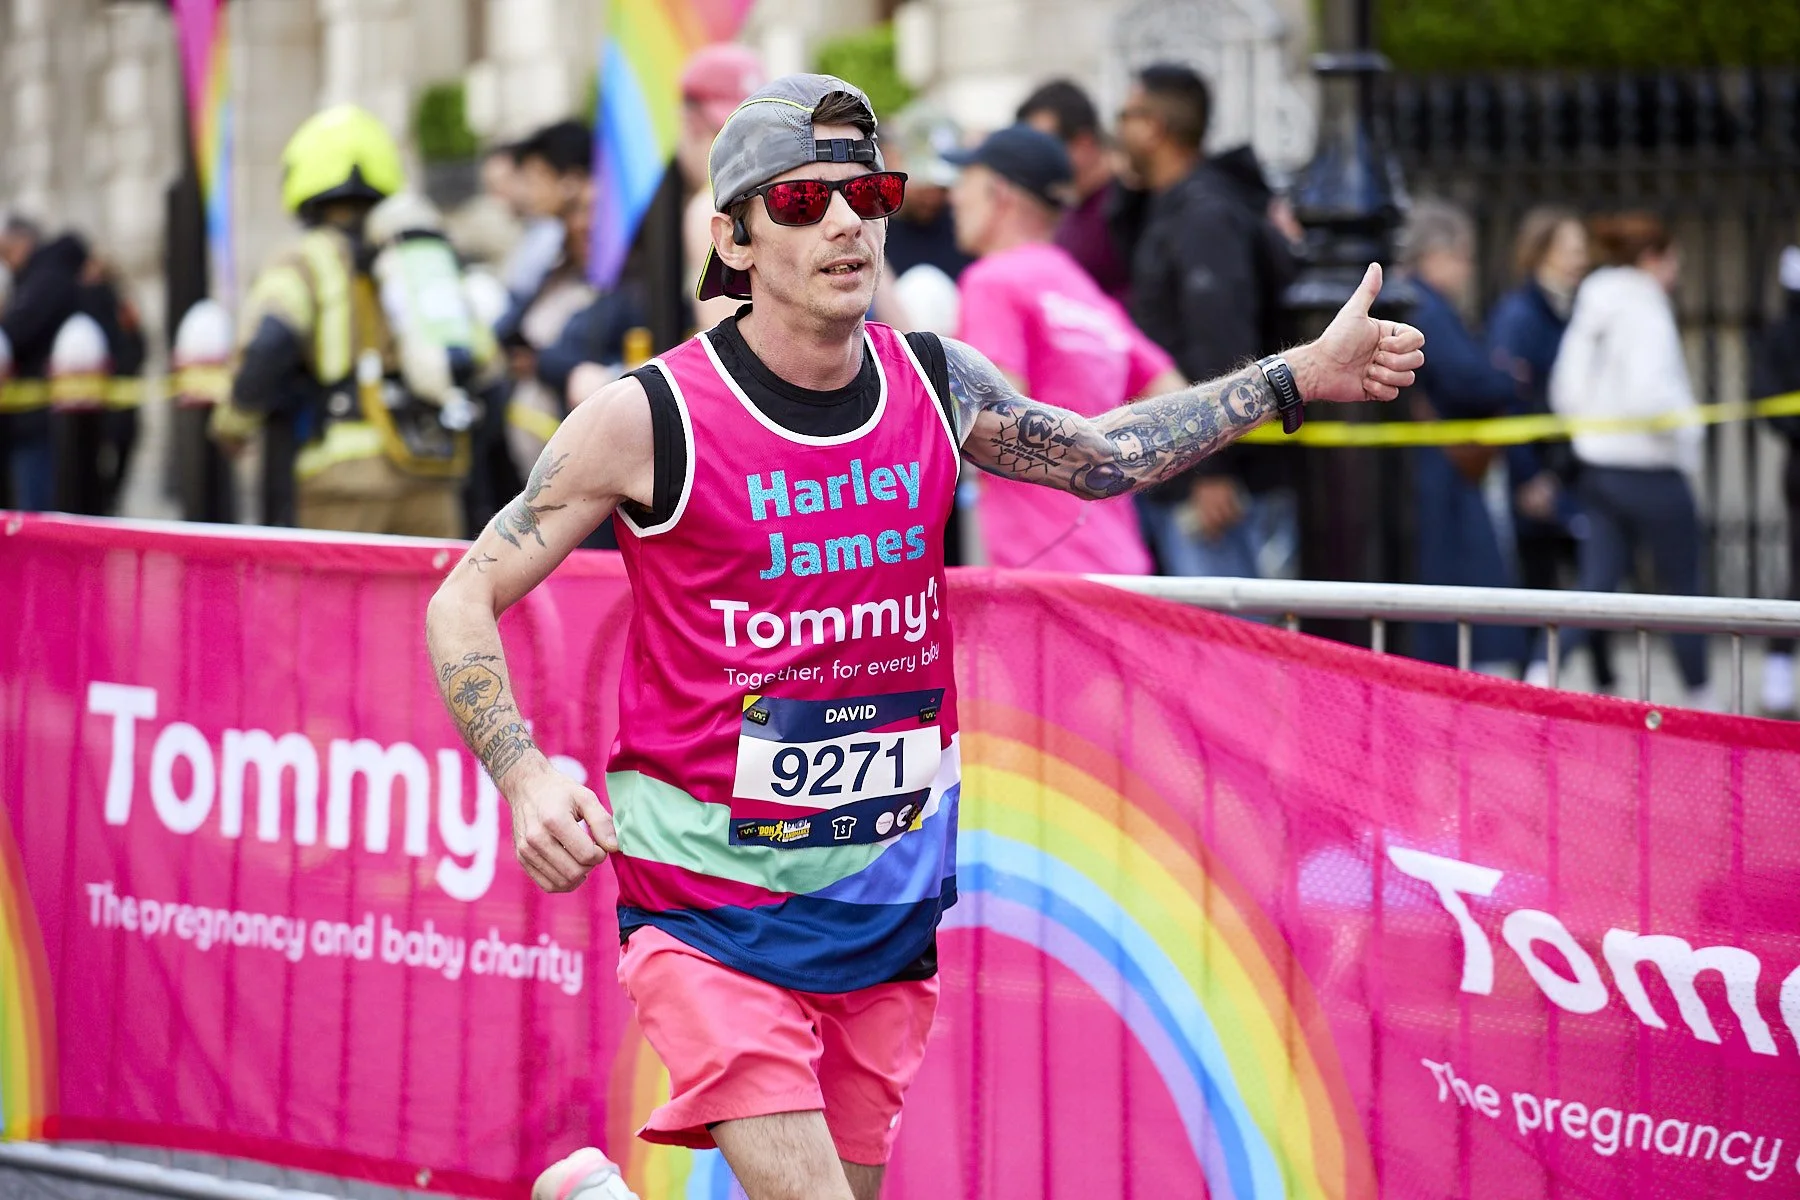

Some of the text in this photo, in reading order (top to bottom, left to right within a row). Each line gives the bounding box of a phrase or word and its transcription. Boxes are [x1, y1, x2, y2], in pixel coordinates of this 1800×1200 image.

[747, 459, 920, 520] Harley
[760, 525, 926, 580] James
[724, 641, 939, 690] Together, for every bby
[825, 704, 877, 724] DAVID
[770, 737, 905, 798] 9271
[840, 824, 846, 835] S
[86, 880, 584, 996] The pregnancy and baby charity
[1387, 845, 1800, 1056] Tom
[1421, 1058, 1783, 1182] The pregnancy
